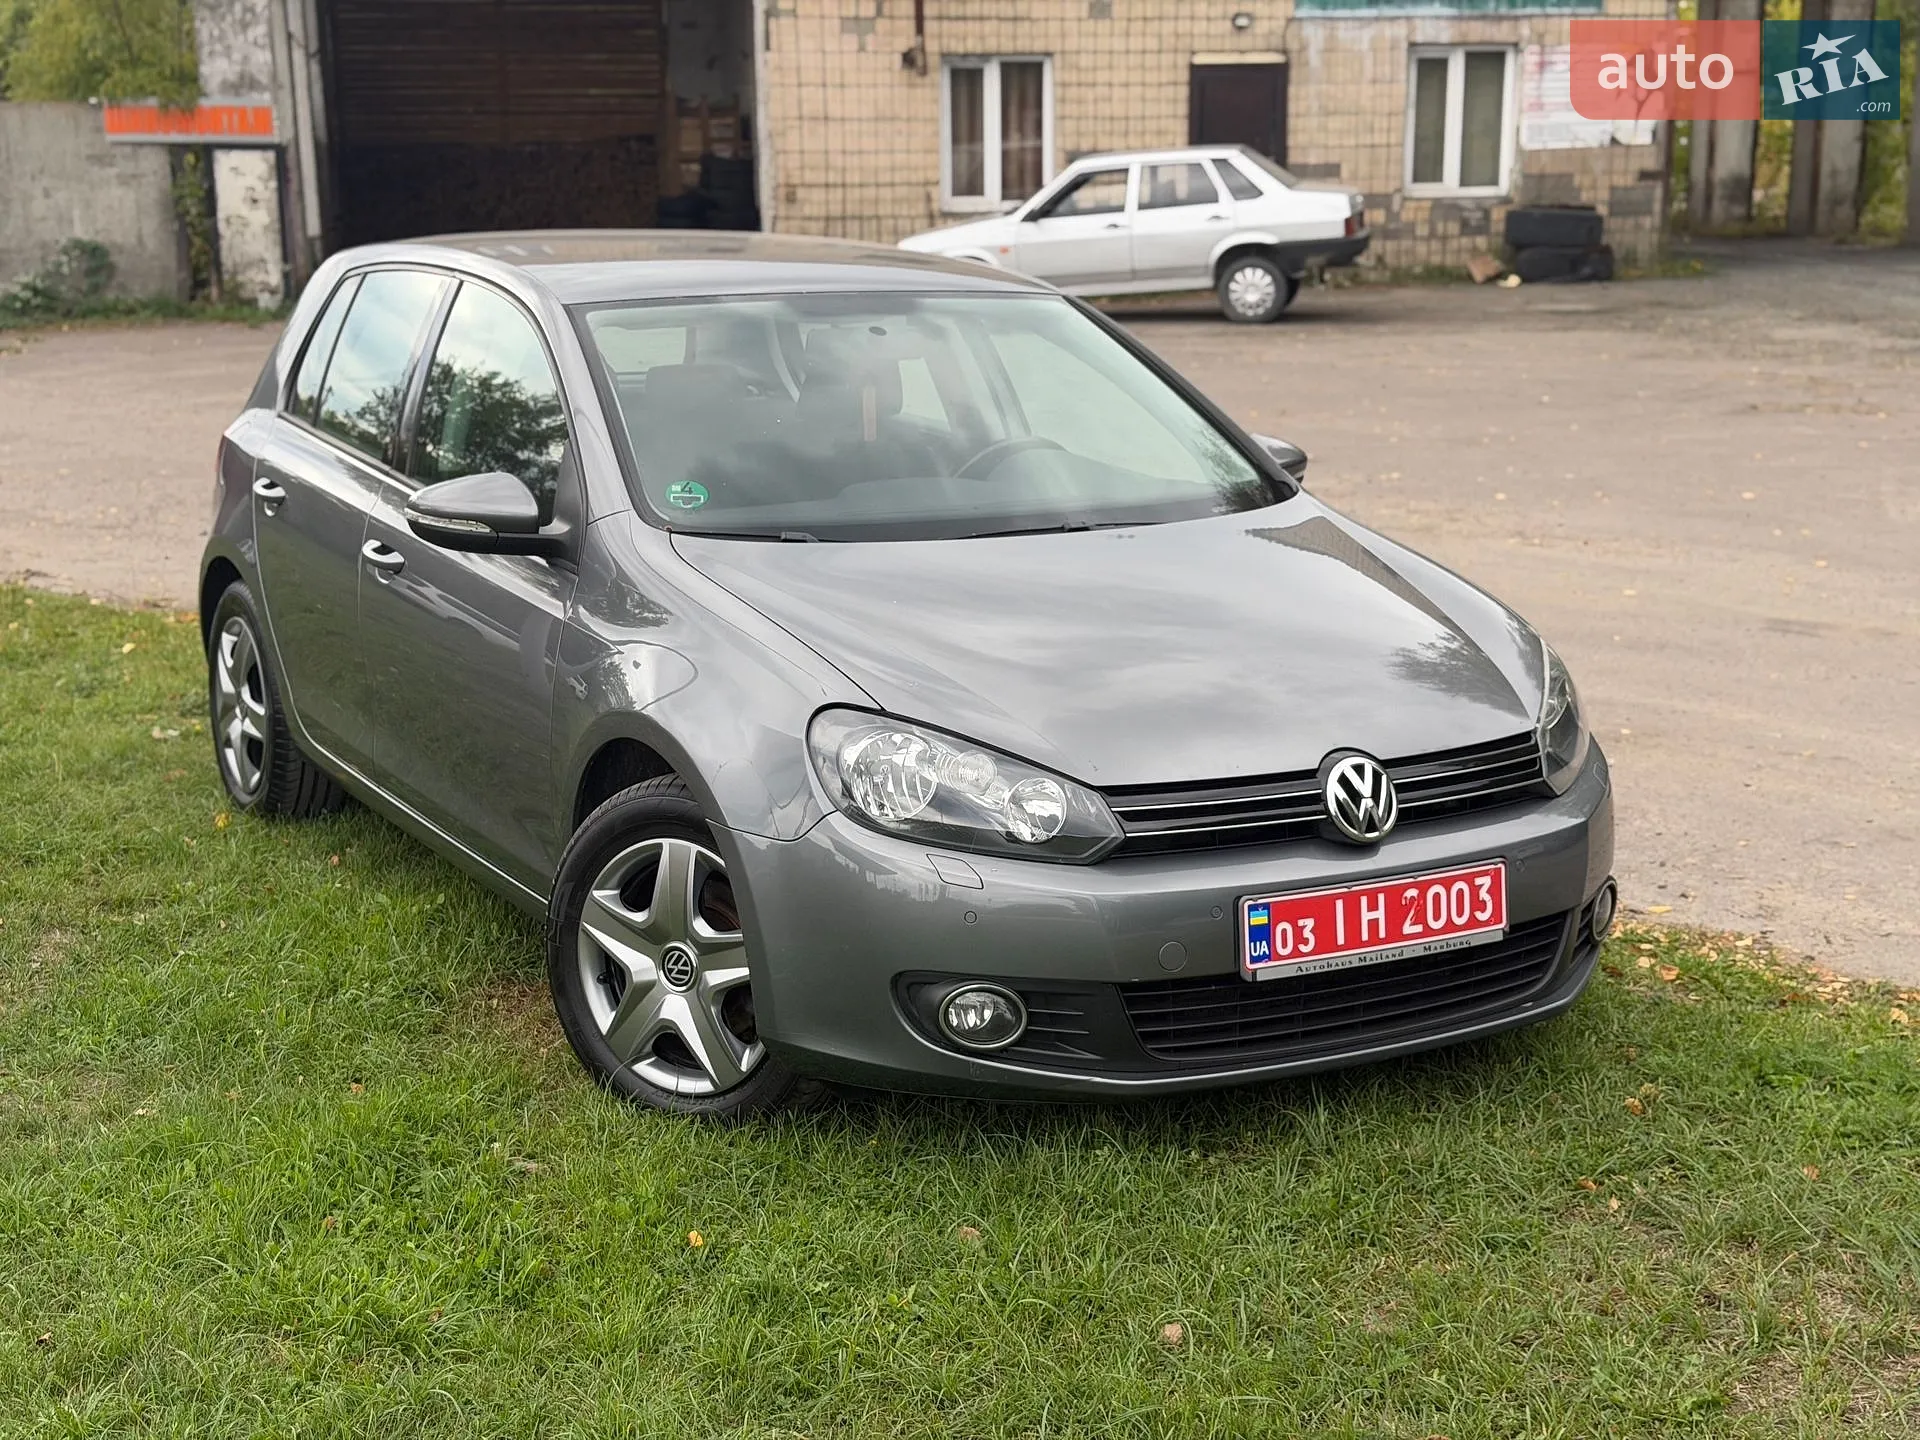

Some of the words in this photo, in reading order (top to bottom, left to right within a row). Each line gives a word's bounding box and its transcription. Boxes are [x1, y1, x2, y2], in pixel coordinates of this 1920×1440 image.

[681, 481, 693, 495] 4
[1275, 917, 1316, 956] 03
[1335, 892, 1387, 946] IH
[1401, 876, 1494, 935] 2003
[1250, 940, 1269, 956] UA
